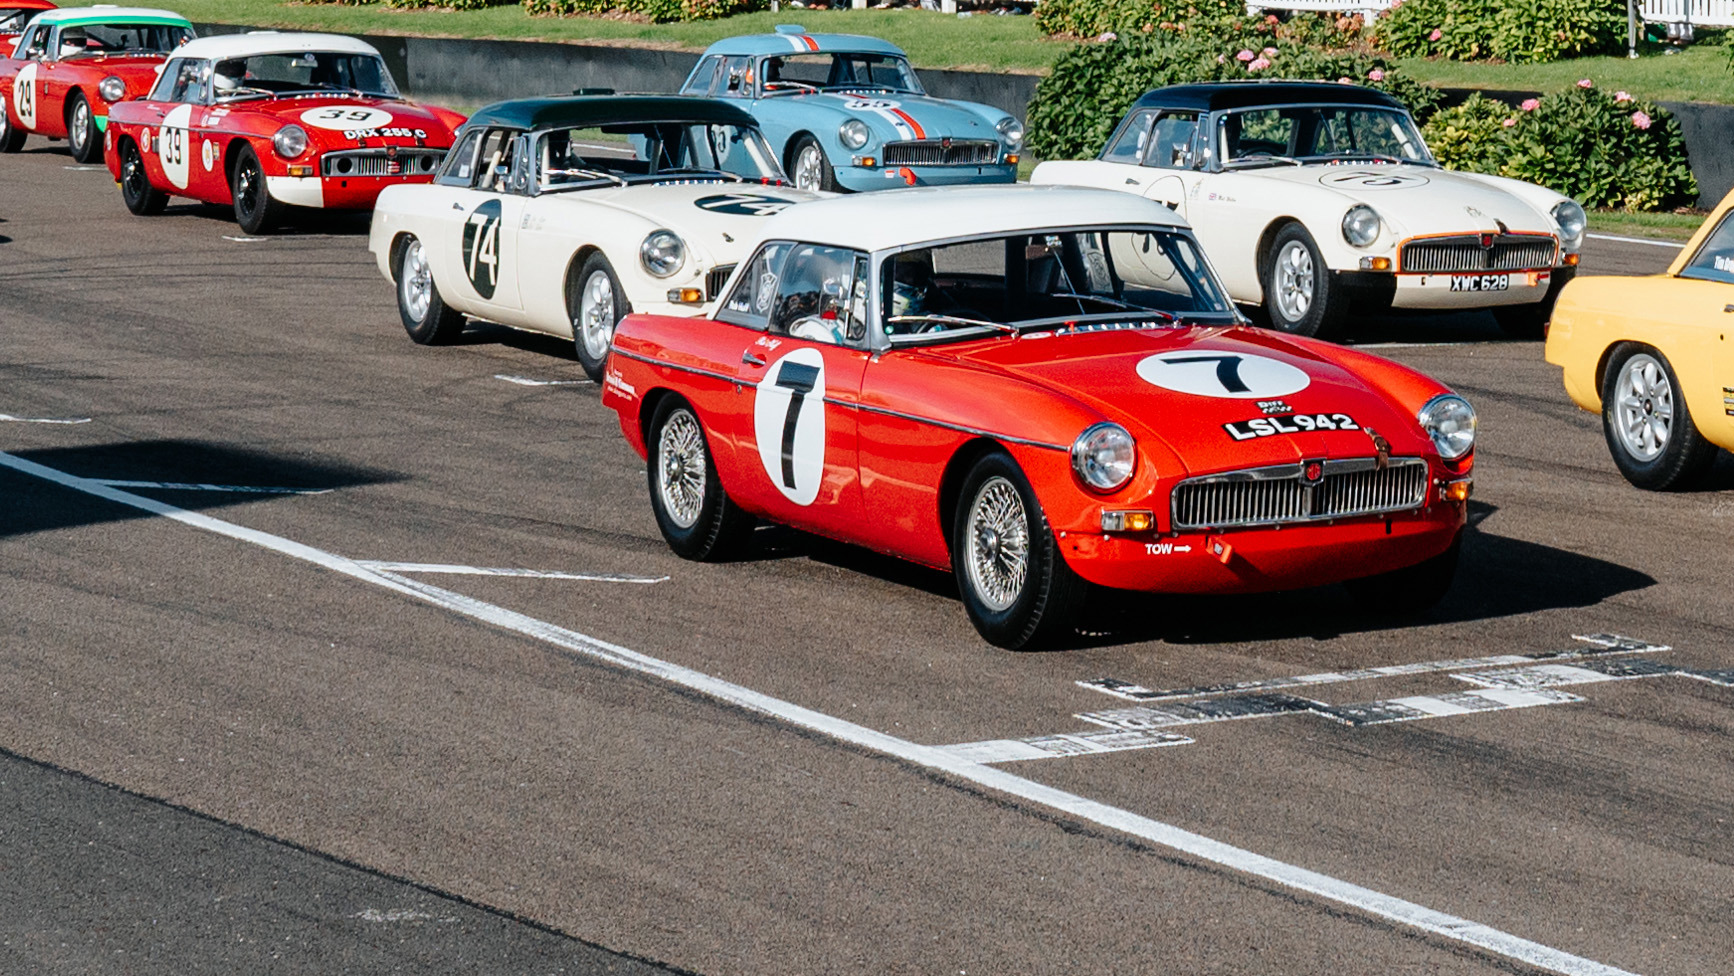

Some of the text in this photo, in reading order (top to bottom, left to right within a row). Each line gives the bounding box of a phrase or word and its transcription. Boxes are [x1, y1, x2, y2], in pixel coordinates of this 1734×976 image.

[18, 80, 32, 117] 29
[319, 109, 373, 122] 39
[165, 127, 181, 165] 39
[1333, 171, 1418, 186] 75
[700, 193, 791, 216] 74
[469, 212, 500, 286] 74
[1451, 275, 1481, 292] XWC
[1158, 355, 1253, 393] 7
[774, 359, 821, 490] 7
[1144, 543, 1173, 555] TOW
